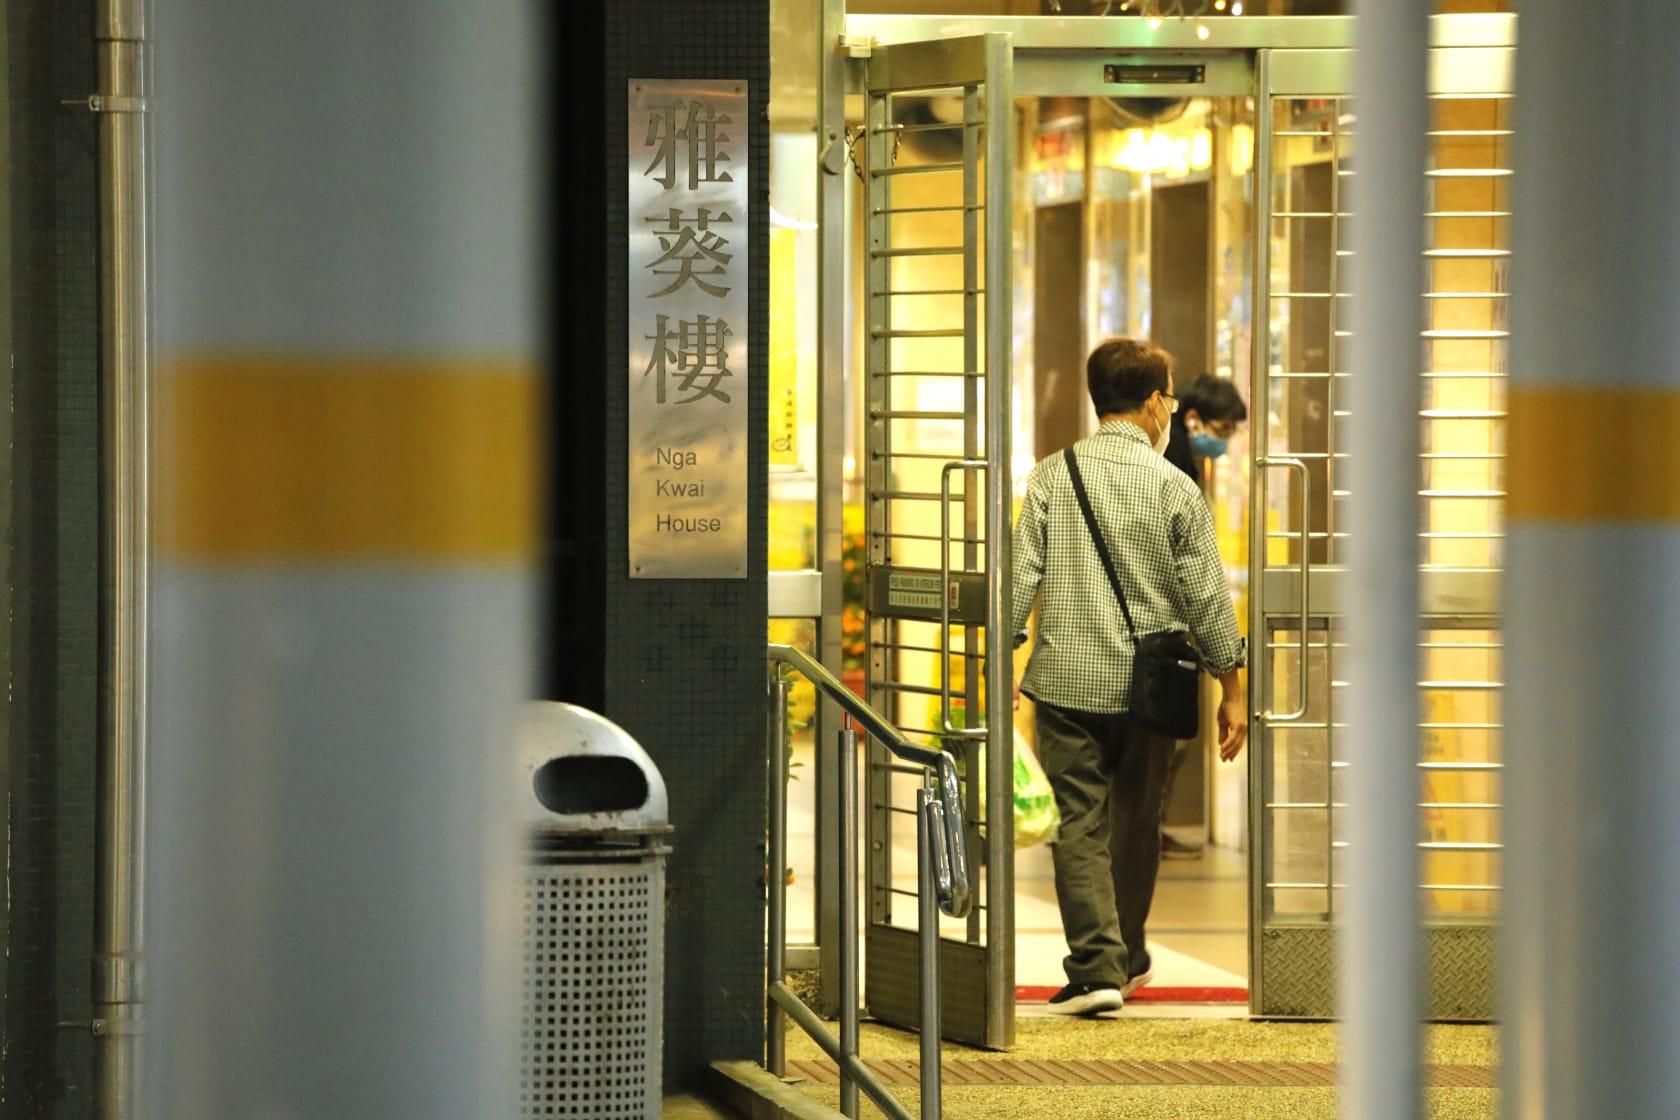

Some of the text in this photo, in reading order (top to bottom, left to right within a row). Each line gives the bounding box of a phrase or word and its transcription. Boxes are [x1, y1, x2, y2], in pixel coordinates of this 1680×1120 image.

[644, 101, 734, 404] 雅葵樓
[656, 447, 697, 470] Nga
[656, 479, 705, 497] Kwai
[656, 514, 721, 532] House
